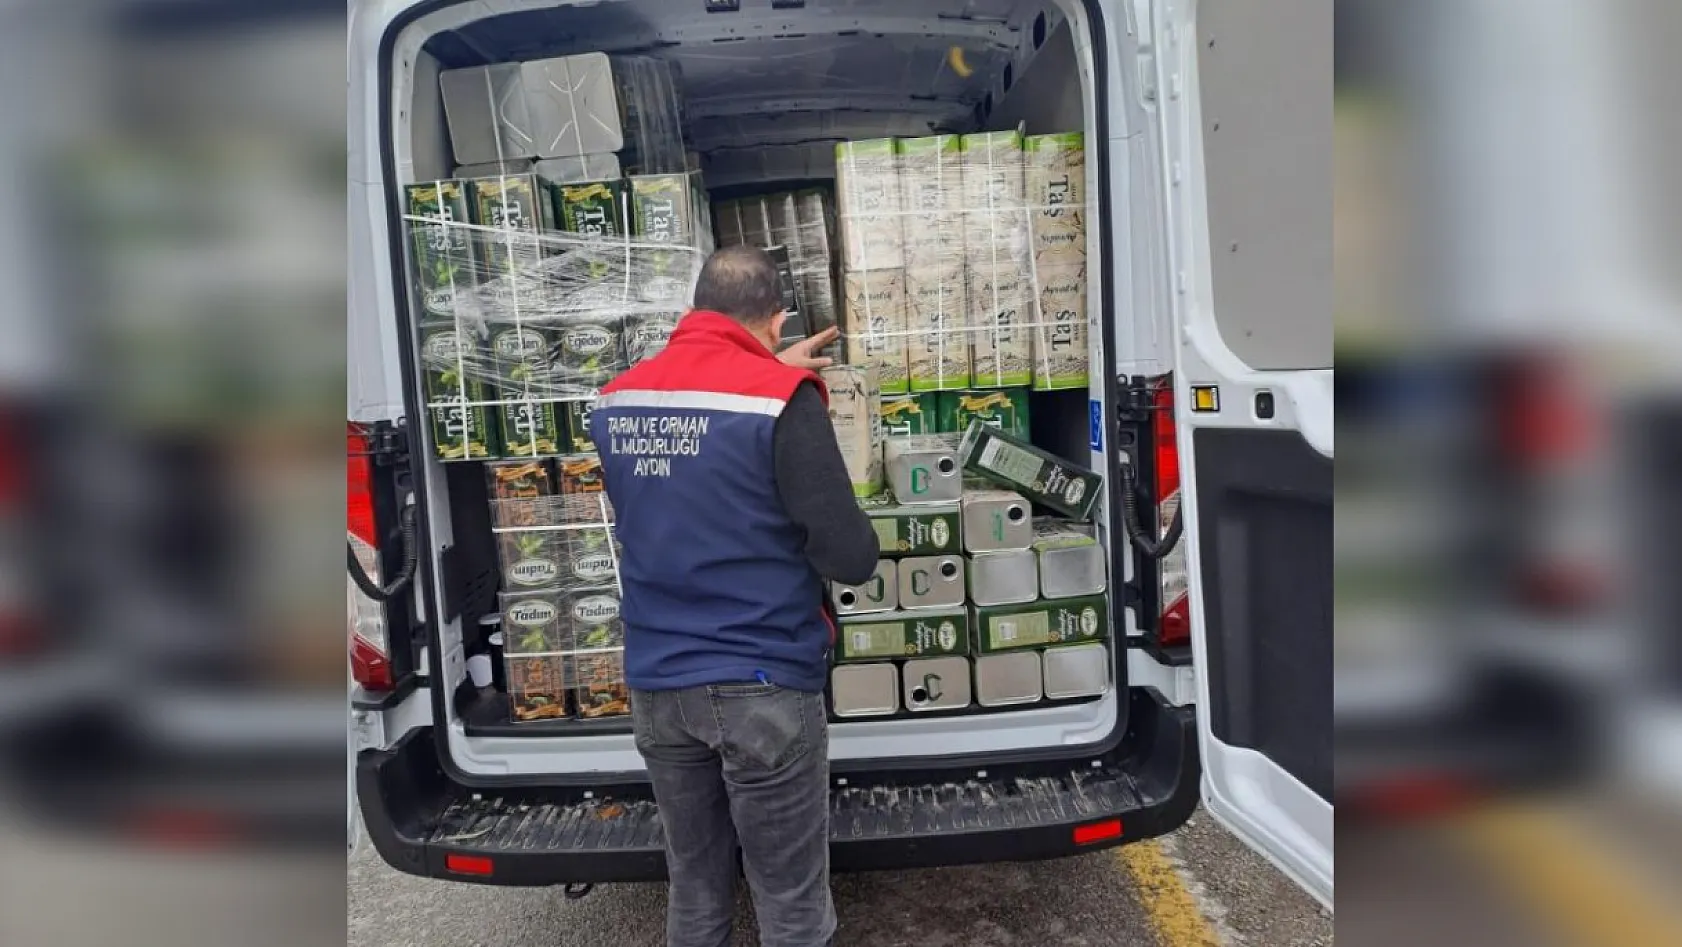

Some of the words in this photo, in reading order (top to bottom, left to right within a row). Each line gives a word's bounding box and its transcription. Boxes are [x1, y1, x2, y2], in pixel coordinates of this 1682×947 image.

[1044, 174, 1069, 218] Taş
[586, 206, 605, 238] Ta
[567, 332, 608, 350] Egeden
[636, 329, 673, 342] Egede
[1051, 310, 1077, 351] Taş
[608, 417, 639, 434] TARIM
[641, 417, 657, 433] VE
[659, 416, 709, 434] ORMAN
[611, 434, 620, 455] İL
[621, 433, 700, 456] MÜDÜRLÜĞÜ
[633, 457, 671, 477] AYDIN
